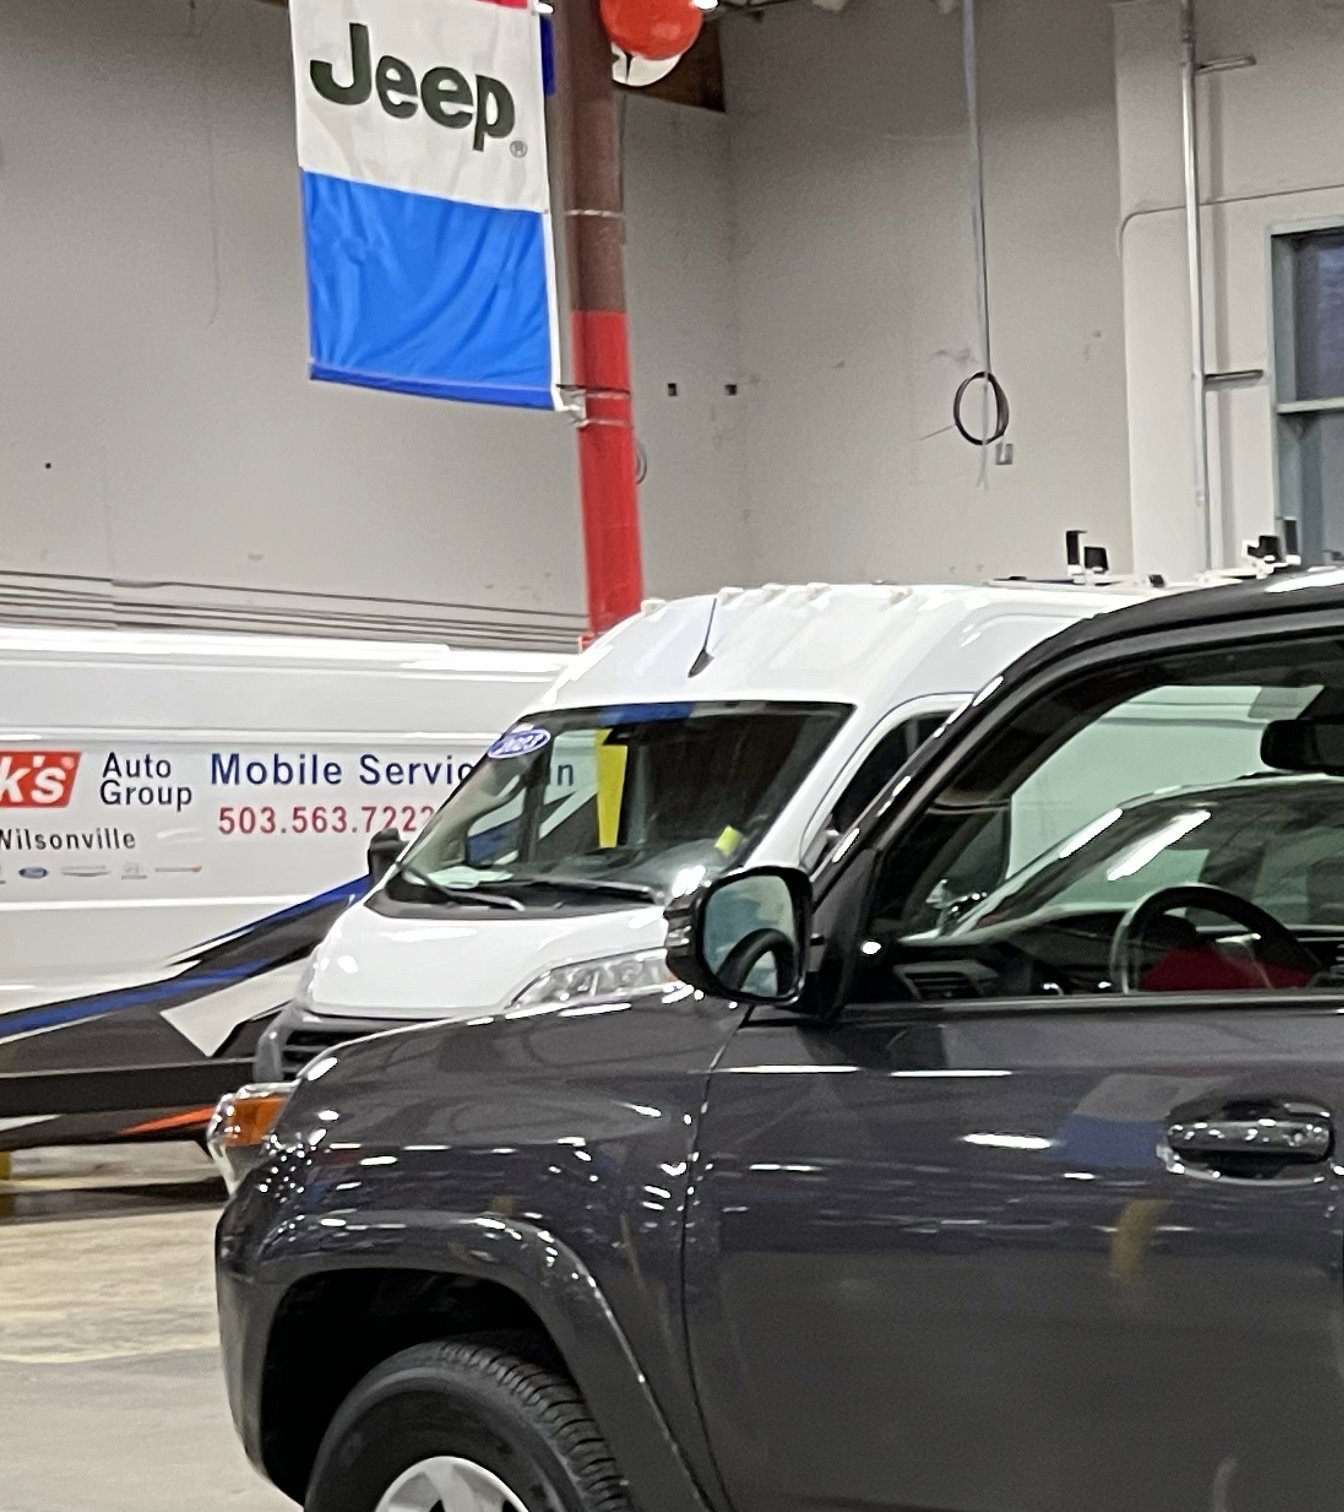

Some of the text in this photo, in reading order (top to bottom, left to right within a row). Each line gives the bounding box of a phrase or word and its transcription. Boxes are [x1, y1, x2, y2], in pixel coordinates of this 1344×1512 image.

[309, 22, 516, 152] Jeep
[102, 751, 172, 779] Auto
[210, 752, 474, 786] Mobile Servic
[99, 779, 193, 813] Group
